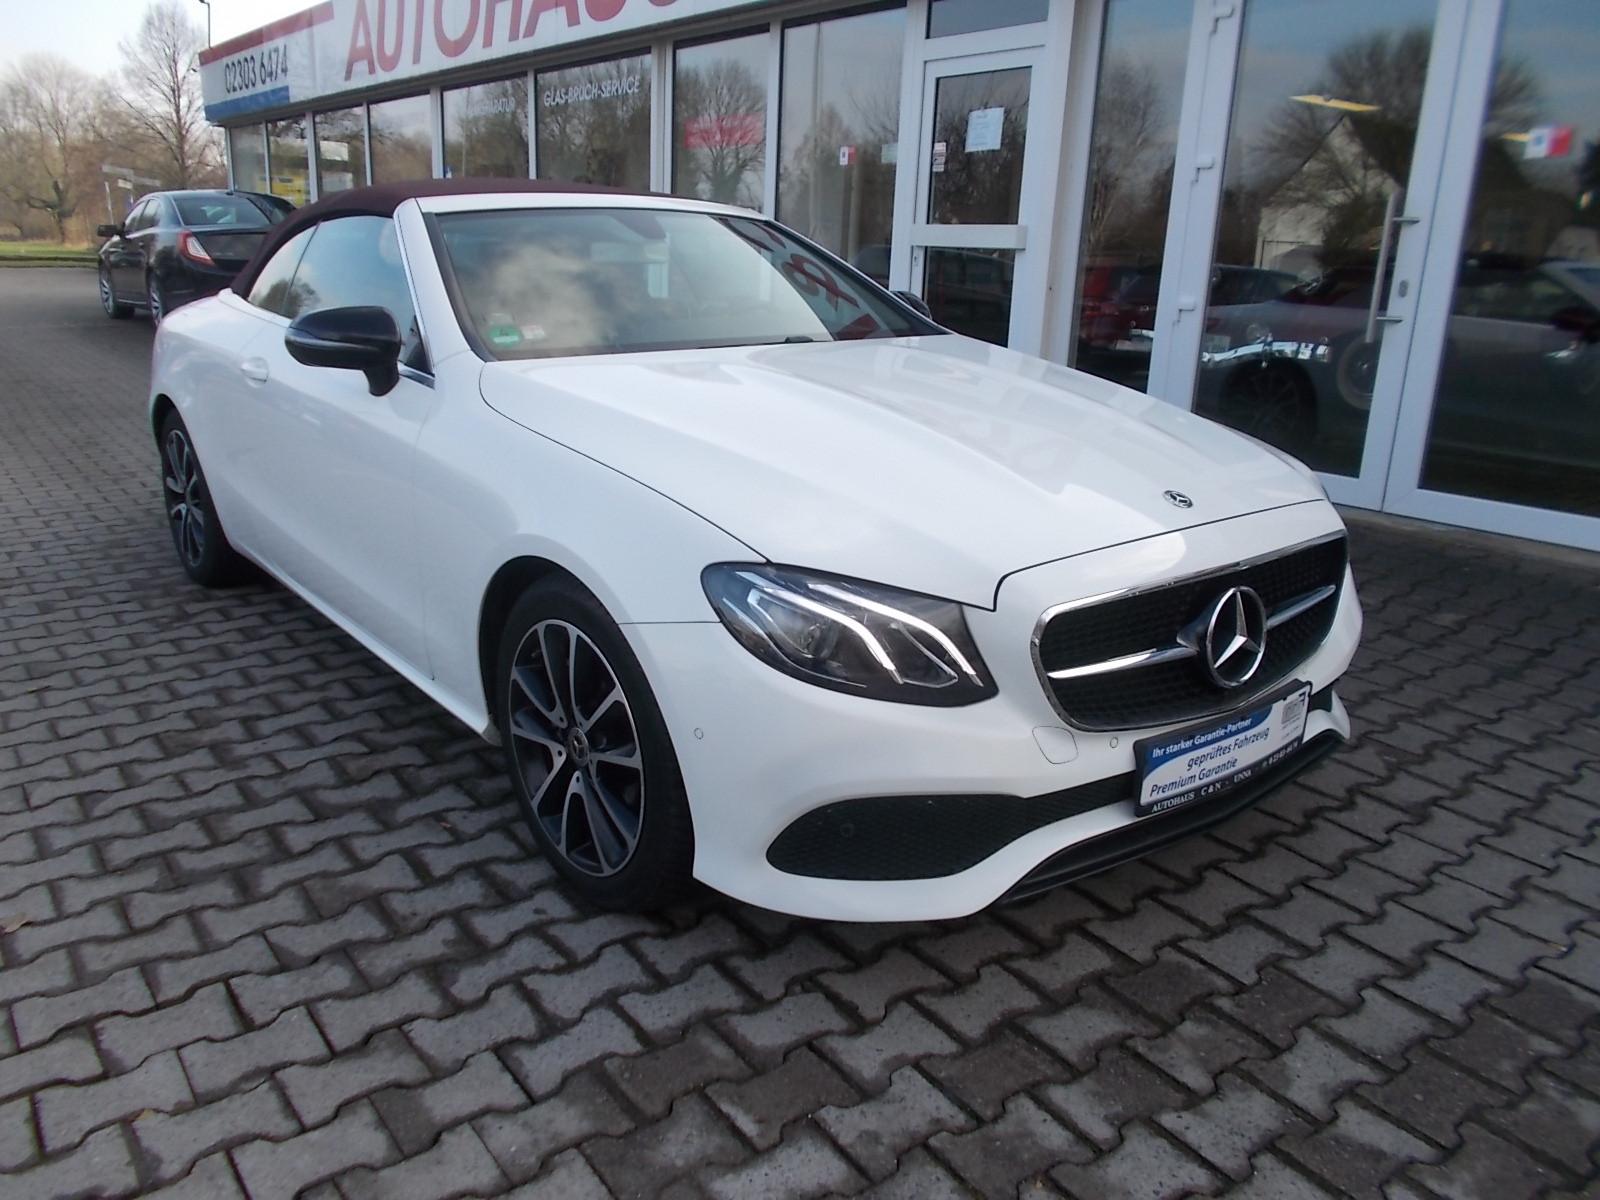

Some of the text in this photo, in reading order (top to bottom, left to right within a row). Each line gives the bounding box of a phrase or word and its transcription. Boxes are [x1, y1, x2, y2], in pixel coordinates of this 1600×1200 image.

[344, 0, 678, 81] AUTOH
[224, 43, 288, 94] 02303 6474
[543, 75, 641, 107] GLAS-BRUCH-SERVICE
[1152, 717, 1252, 759] Ihr starker Garantie-Partner
[1187, 743, 1232, 771] geprüftes
[1232, 727, 1270, 751] Fahrzeug
[1149, 757, 1238, 798] Premium Garantie
[1151, 791, 1195, 813] AUTOHAUS
